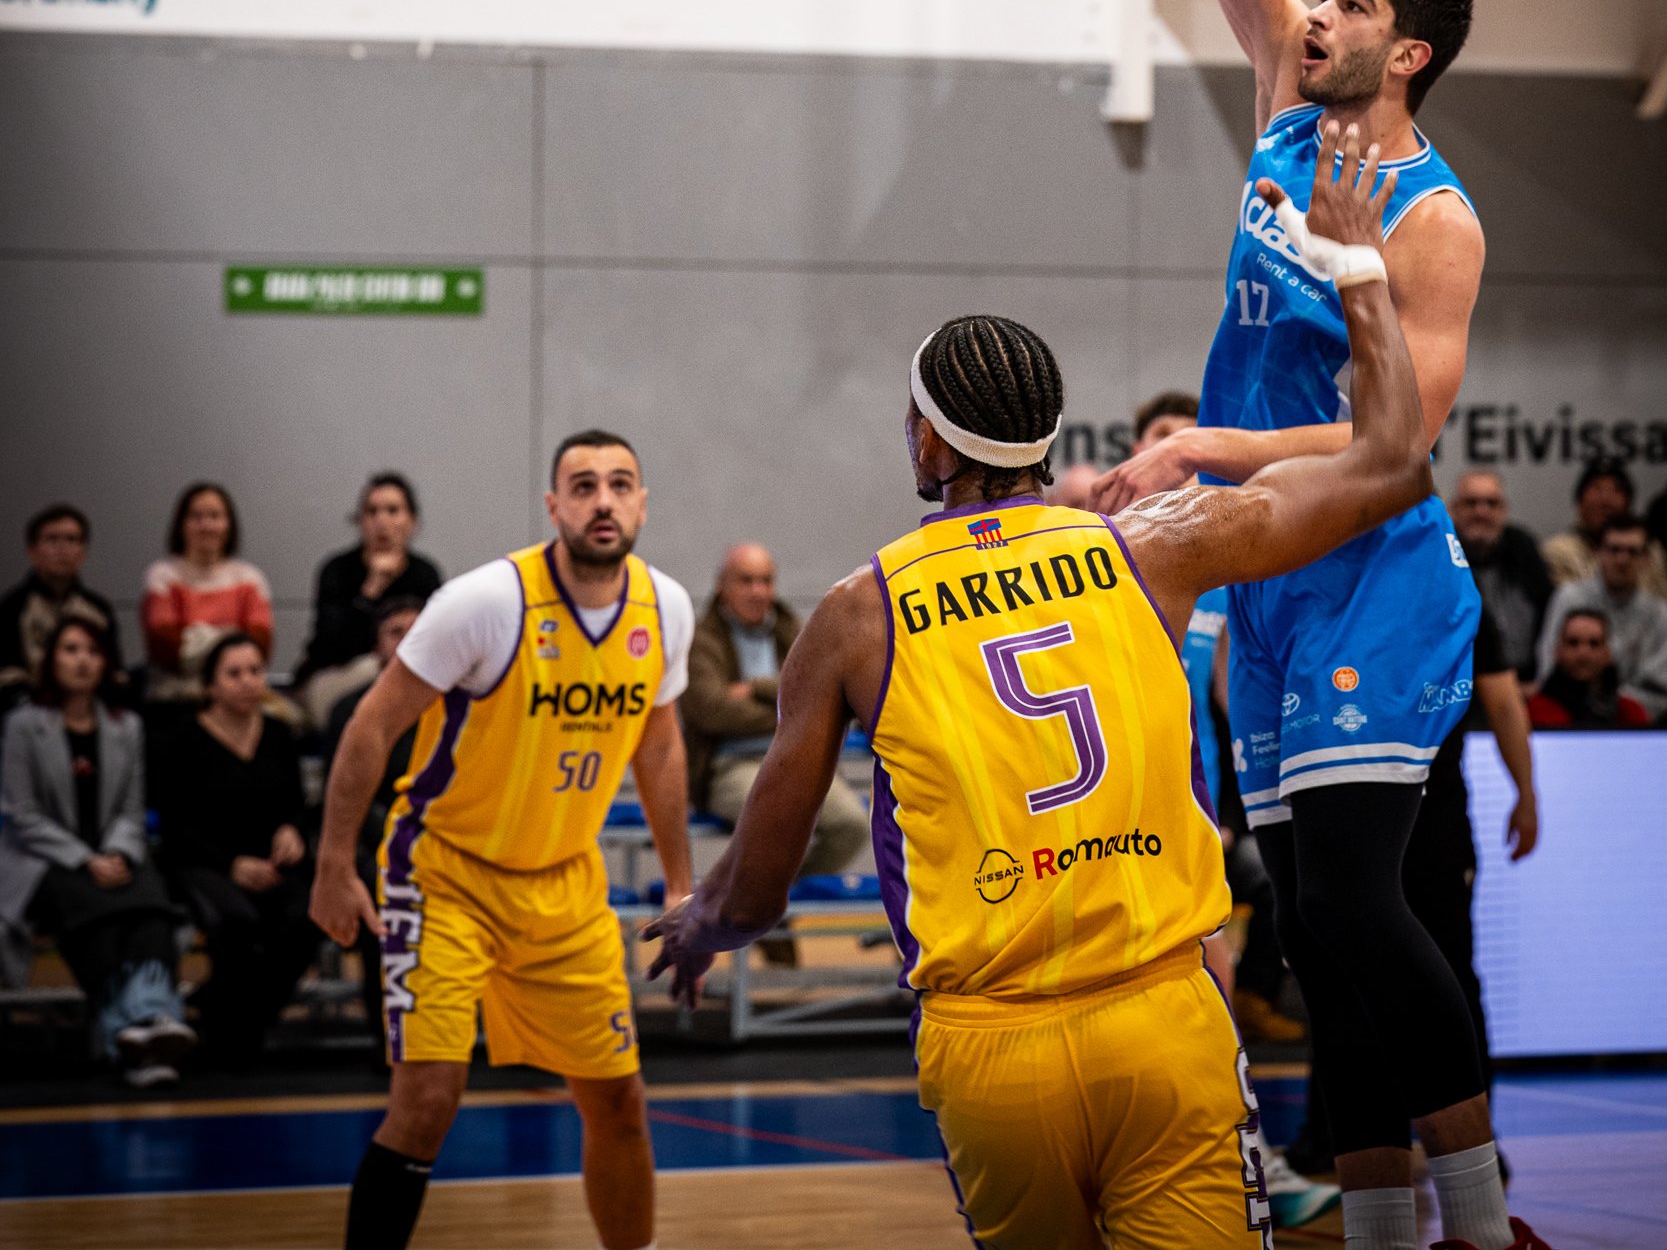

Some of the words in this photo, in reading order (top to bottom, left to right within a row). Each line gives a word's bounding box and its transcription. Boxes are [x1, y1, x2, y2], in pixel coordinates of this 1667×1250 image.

[1257, 253, 1288, 280] Rent
[1288, 276, 1300, 287] a
[1300, 284, 1328, 302] car
[1236, 279, 1270, 327] 17
[899, 547, 1118, 635] GARRIDO
[529, 682, 646, 717] HOMS
[978, 620, 1108, 815] 5
[553, 751, 602, 792] 50
[974, 865, 1024, 886] NISSAN
[1032, 828, 1162, 880] Romauto
